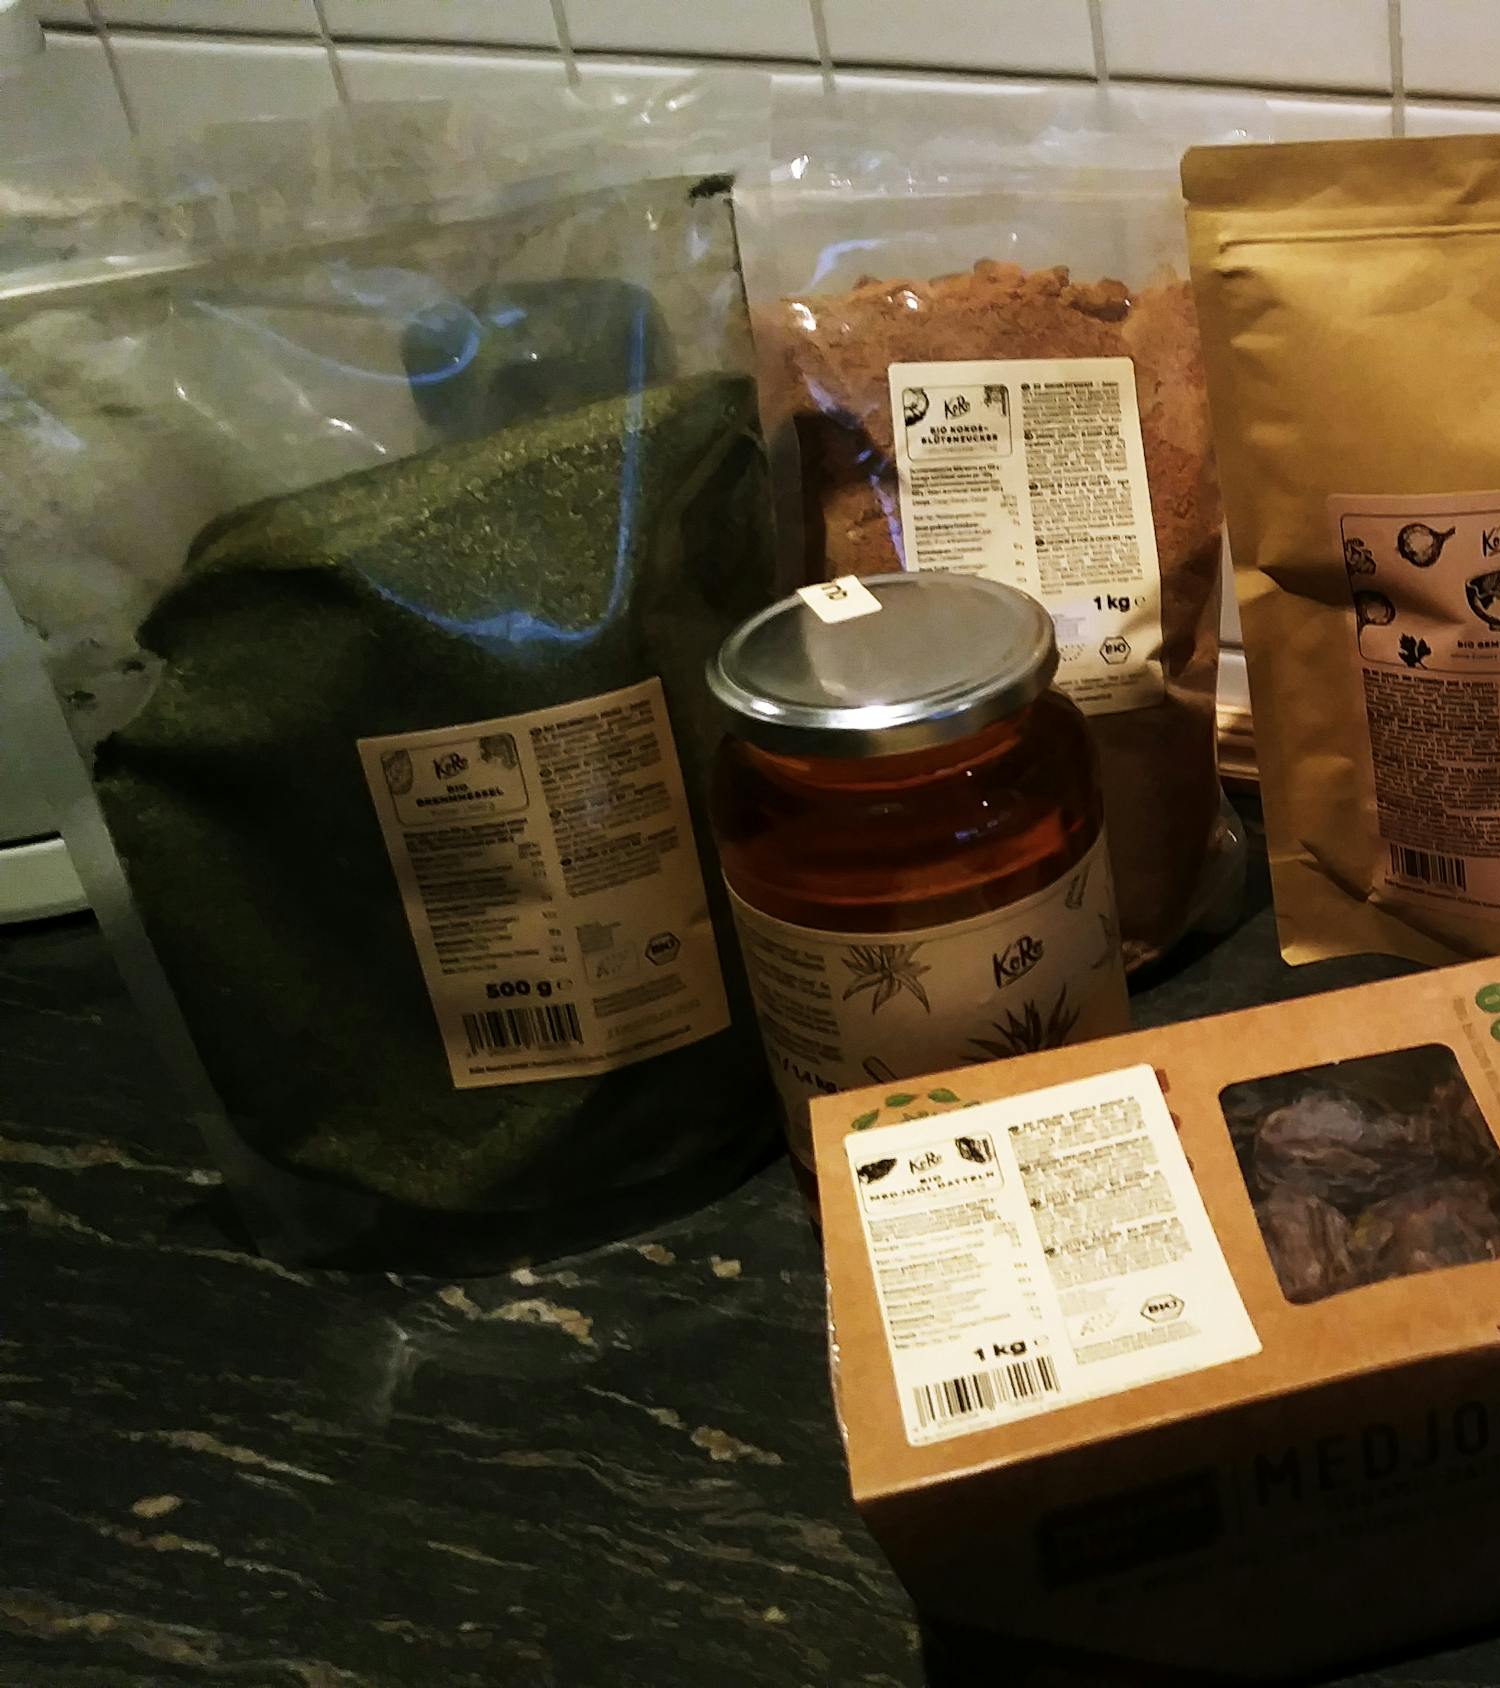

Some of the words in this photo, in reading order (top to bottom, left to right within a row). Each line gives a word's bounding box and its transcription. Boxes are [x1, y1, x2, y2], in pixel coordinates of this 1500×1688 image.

[1093, 594, 1103, 611] 1
[1107, 594, 1130, 612] kg
[992, 934, 1044, 988] KoRo
[486, 980, 531, 998] 500
[536, 982, 552, 997] g
[974, 1347, 985, 1361] 1
[994, 1339, 1027, 1357] kg
